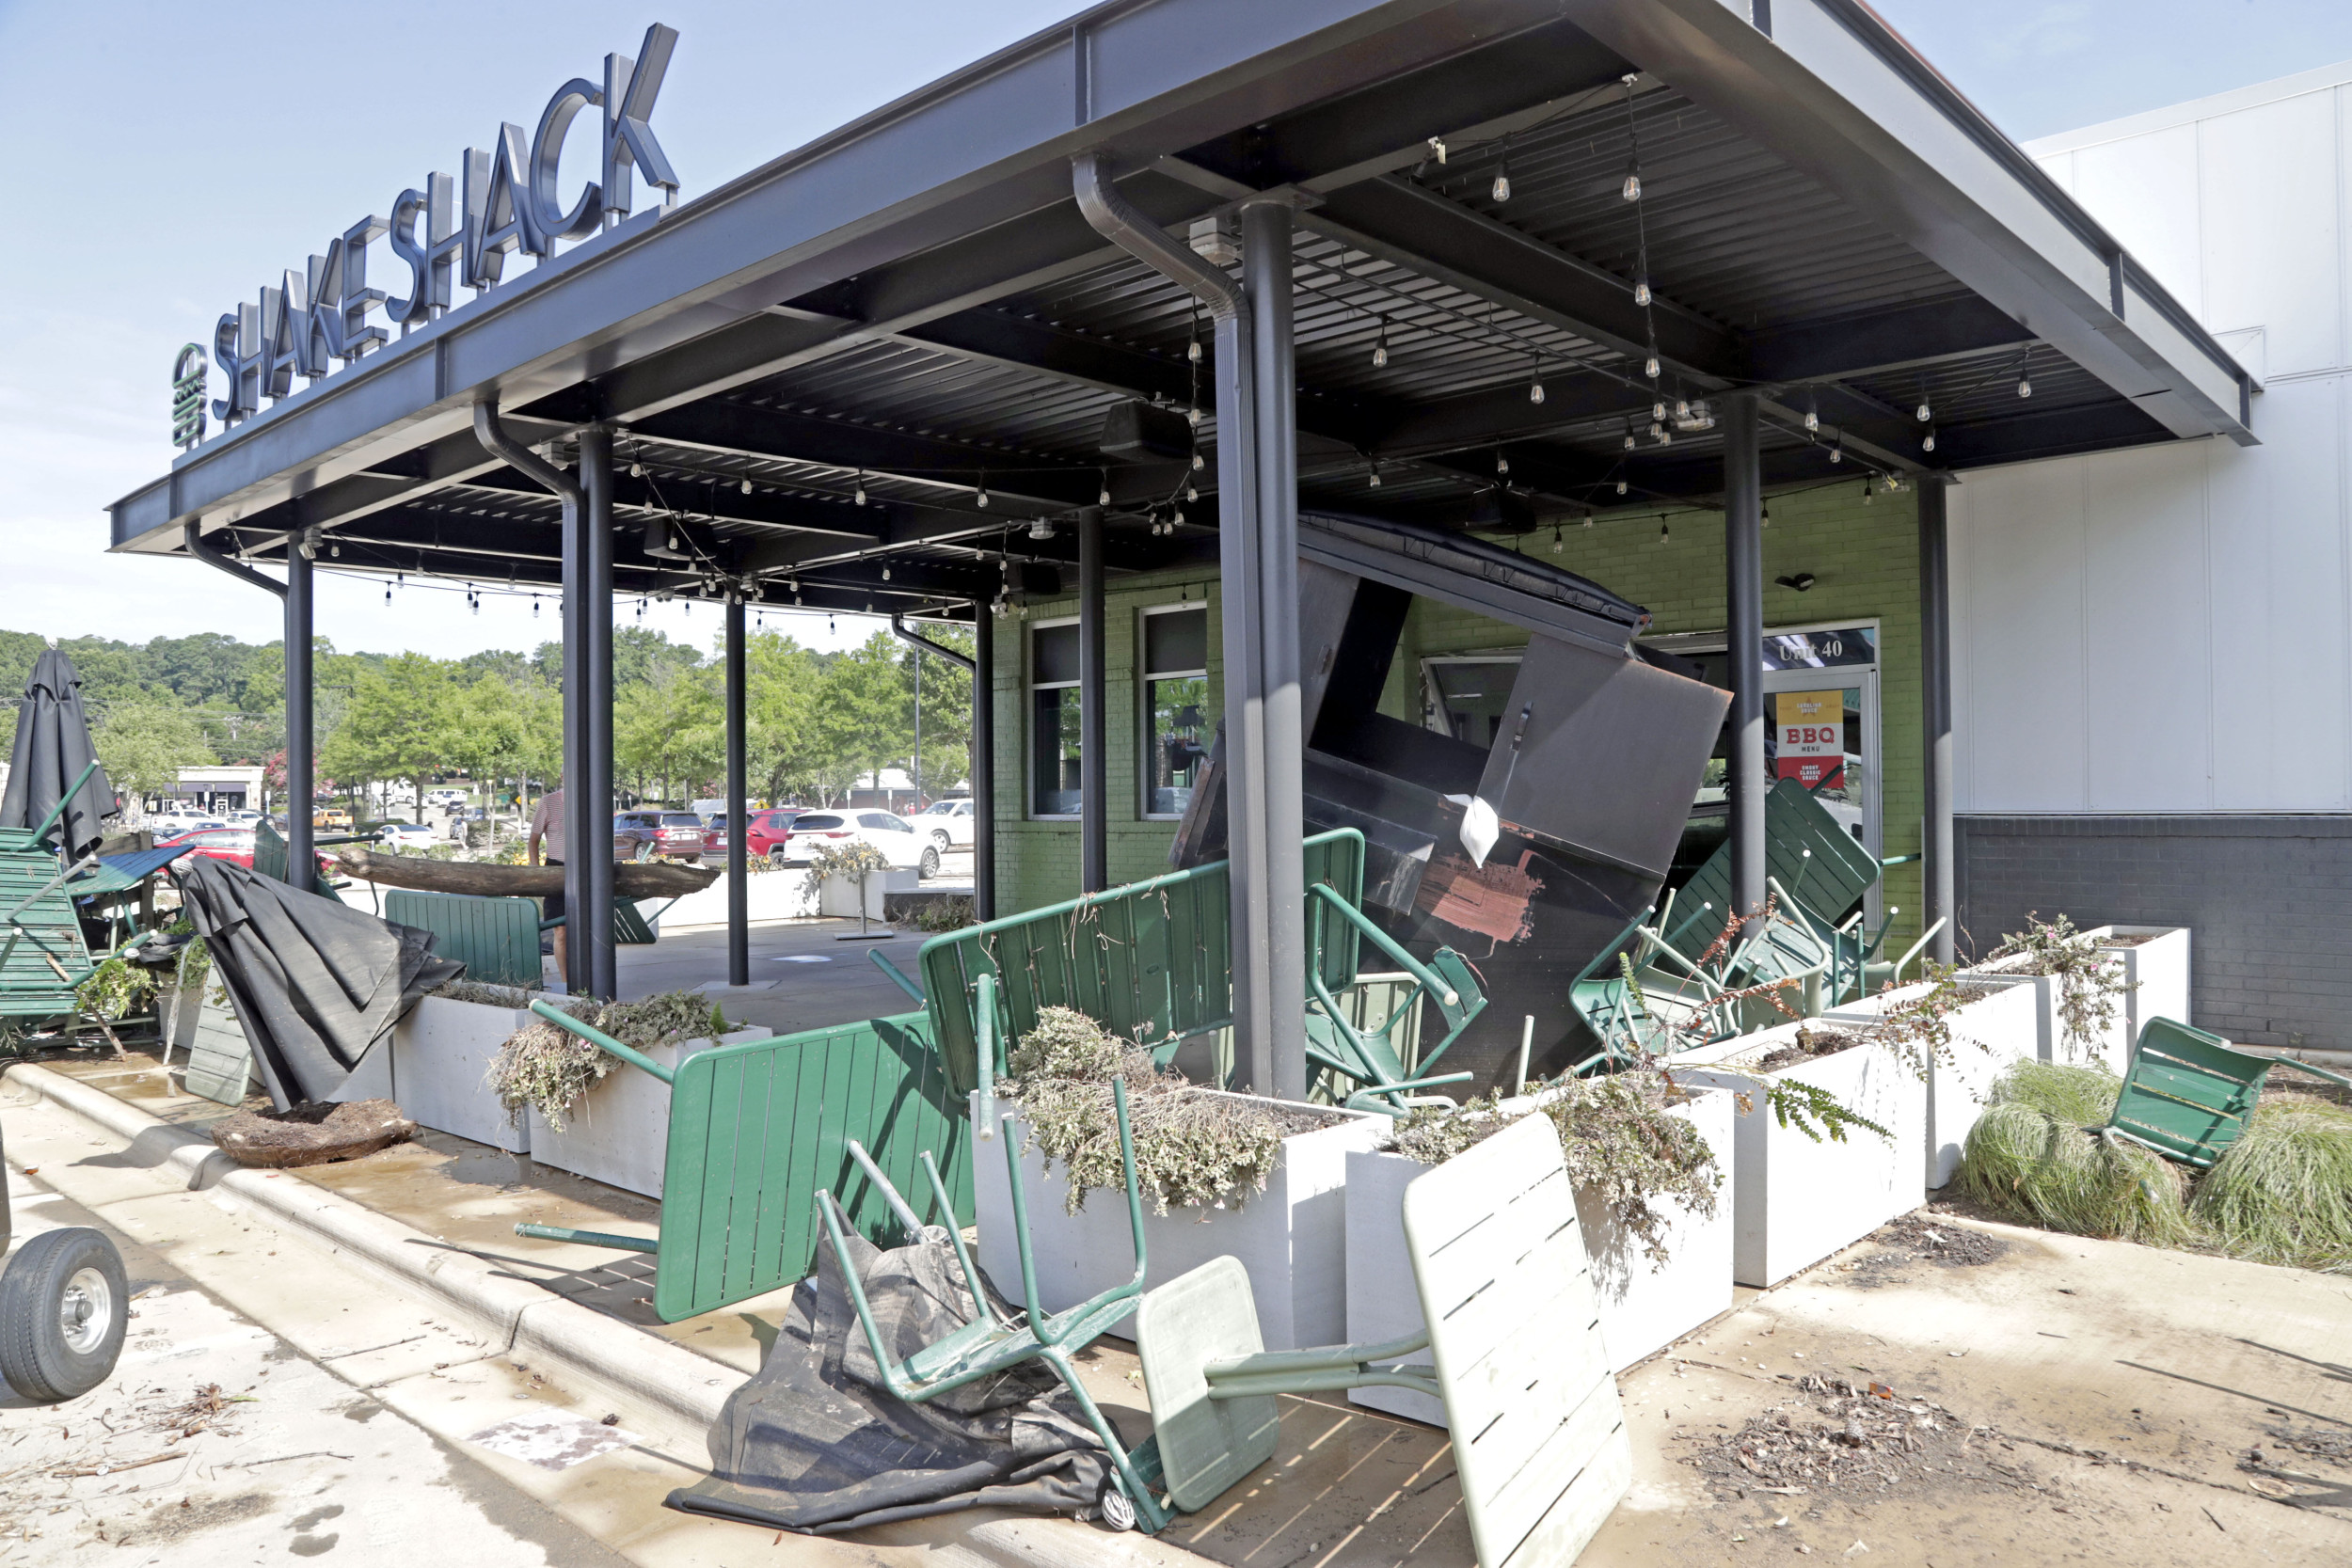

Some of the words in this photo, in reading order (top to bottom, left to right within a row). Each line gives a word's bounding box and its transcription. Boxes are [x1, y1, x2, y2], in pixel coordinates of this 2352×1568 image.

[213, 214, 389, 421] SHAKE
[386, 22, 680, 325] SHACK
[1779, 644, 1817, 661] Unit
[1822, 641, 1842, 657] 40
[1787, 727, 1835, 744] BBQ
